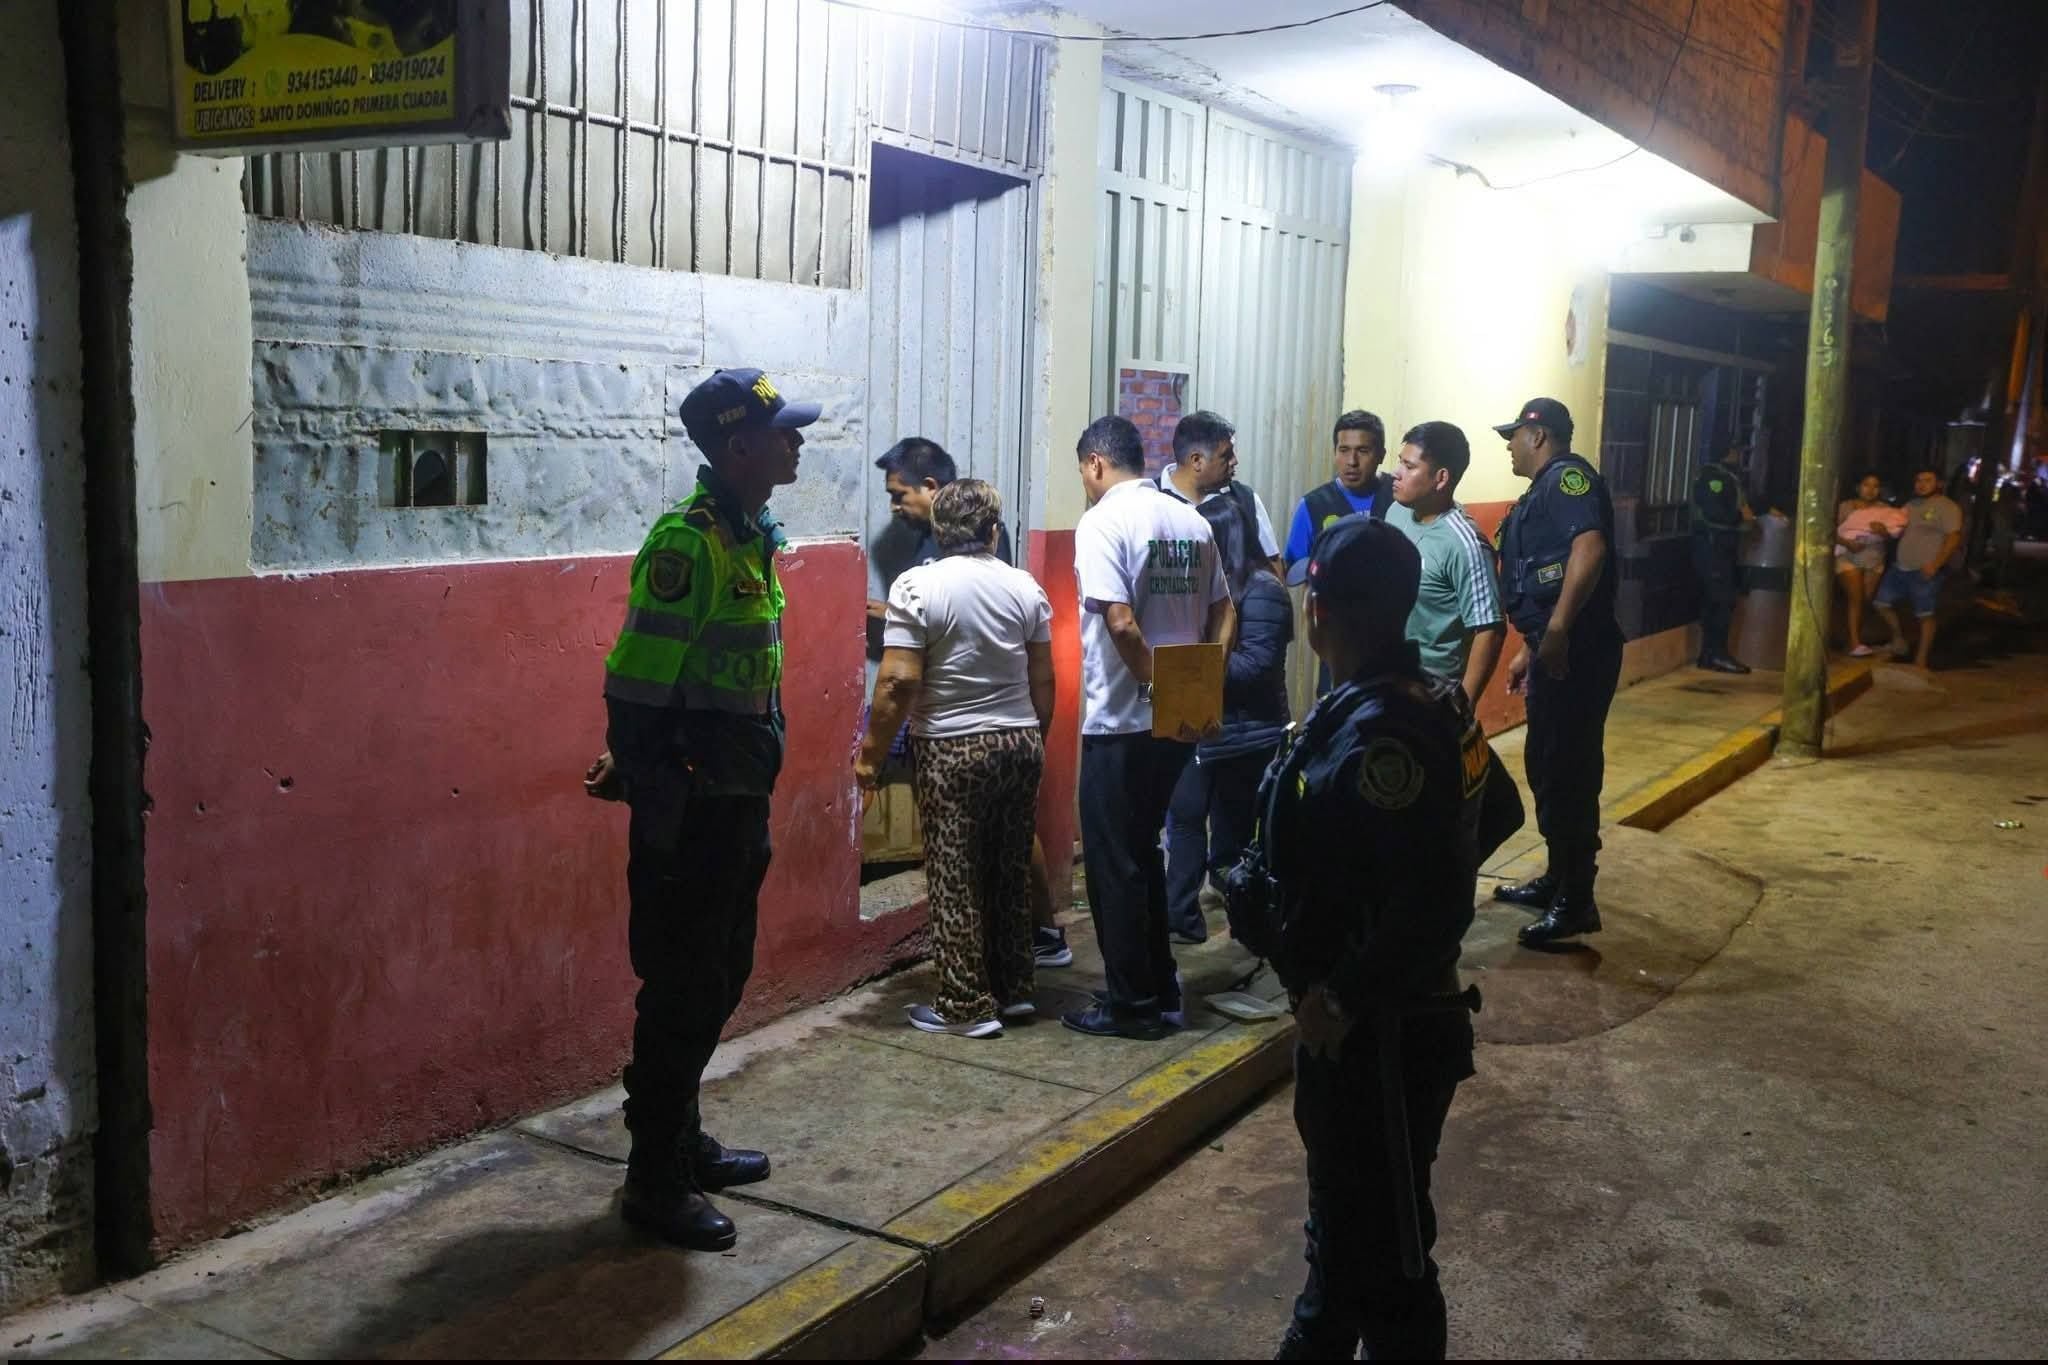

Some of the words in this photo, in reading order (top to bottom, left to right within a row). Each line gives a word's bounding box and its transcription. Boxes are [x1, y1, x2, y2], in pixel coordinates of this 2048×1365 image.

[193, 76, 246, 103] DELIVERY
[287, 64, 358, 93] 934153440
[259, 104, 293, 123] SANTO
[352, 92, 399, 113] PRIMERA
[402, 89, 448, 110] CUADRA
[1148, 540, 1201, 568] POLICIA
